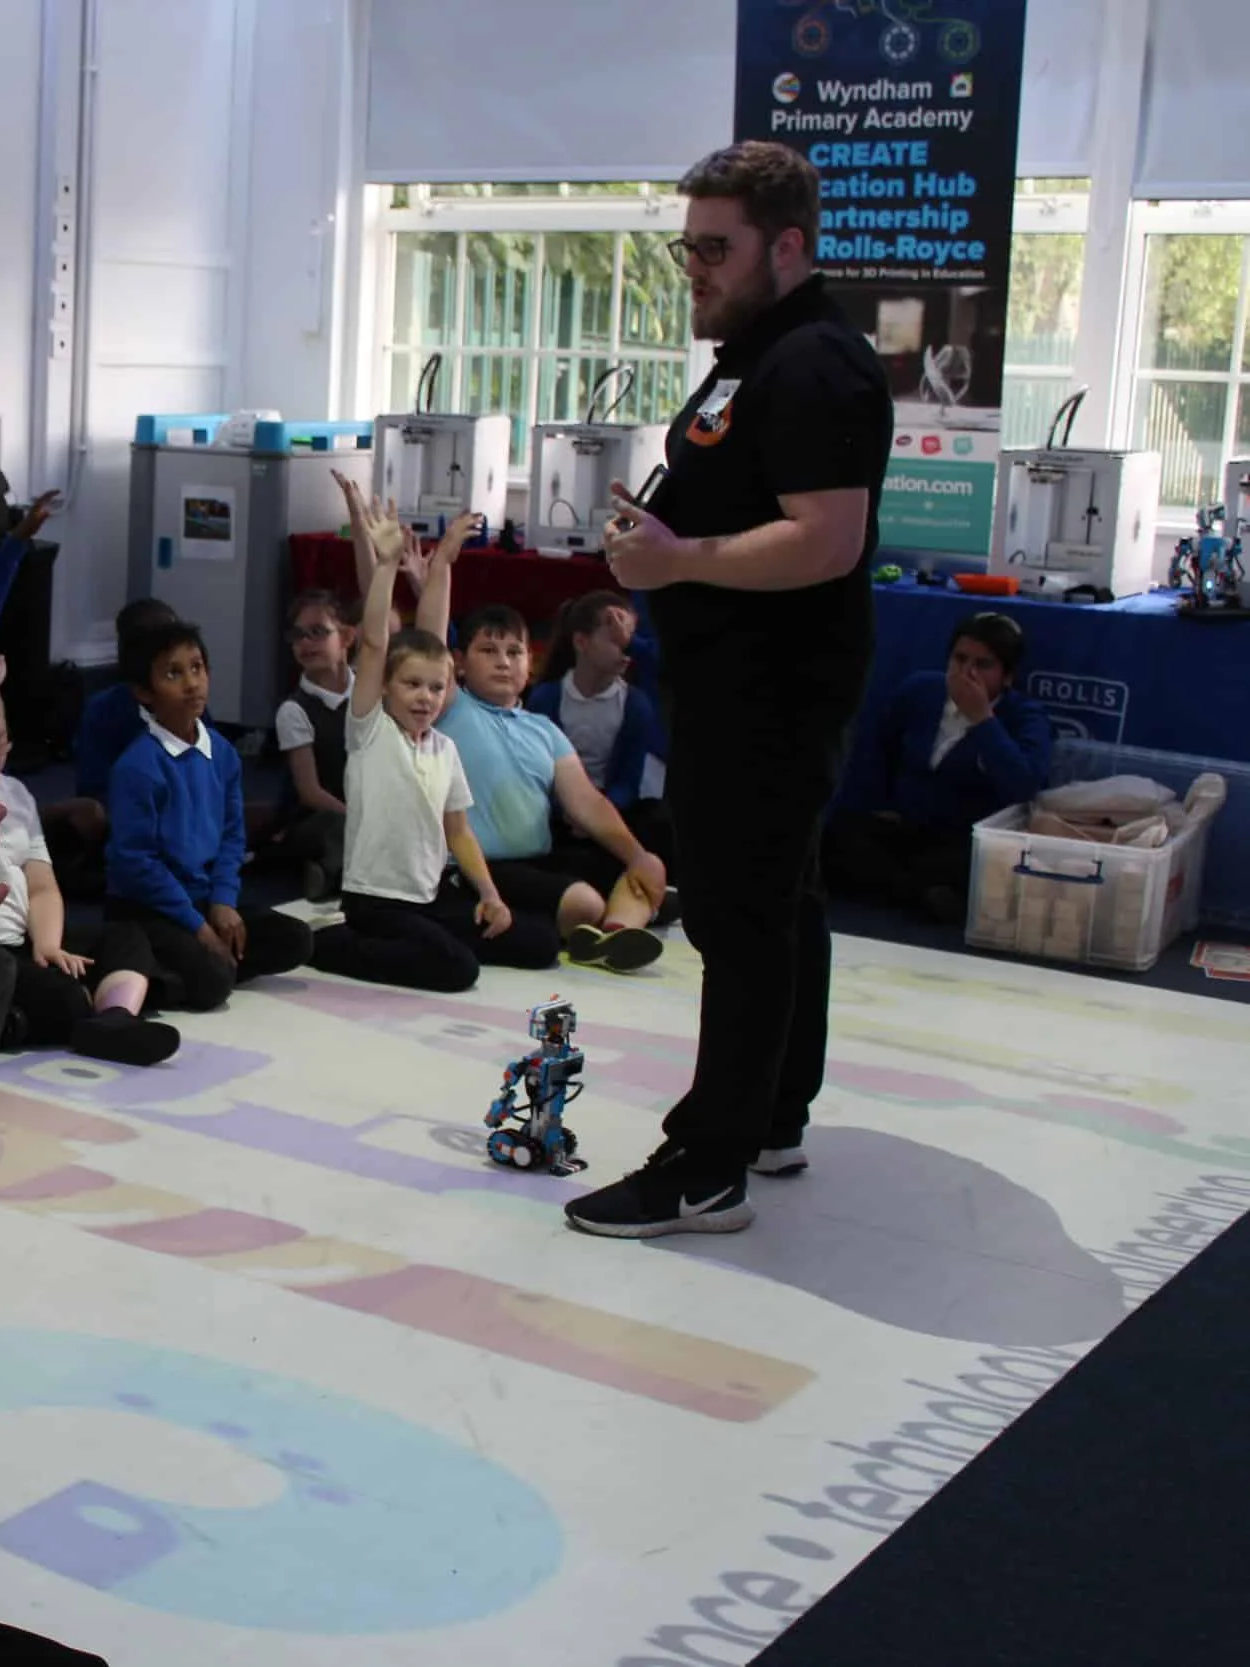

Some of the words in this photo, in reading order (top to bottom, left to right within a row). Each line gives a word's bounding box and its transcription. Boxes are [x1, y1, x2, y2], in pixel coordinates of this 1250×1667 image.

[817, 79, 933, 106] Wyndham
[771, 109, 857, 134] Primary
[863, 107, 974, 132] Academy
[808, 140, 929, 167] CREATE
[913, 173, 977, 197] Hub
[816, 235, 986, 266] Rolls-Royce
[1037, 679, 1118, 707] ROLLS
